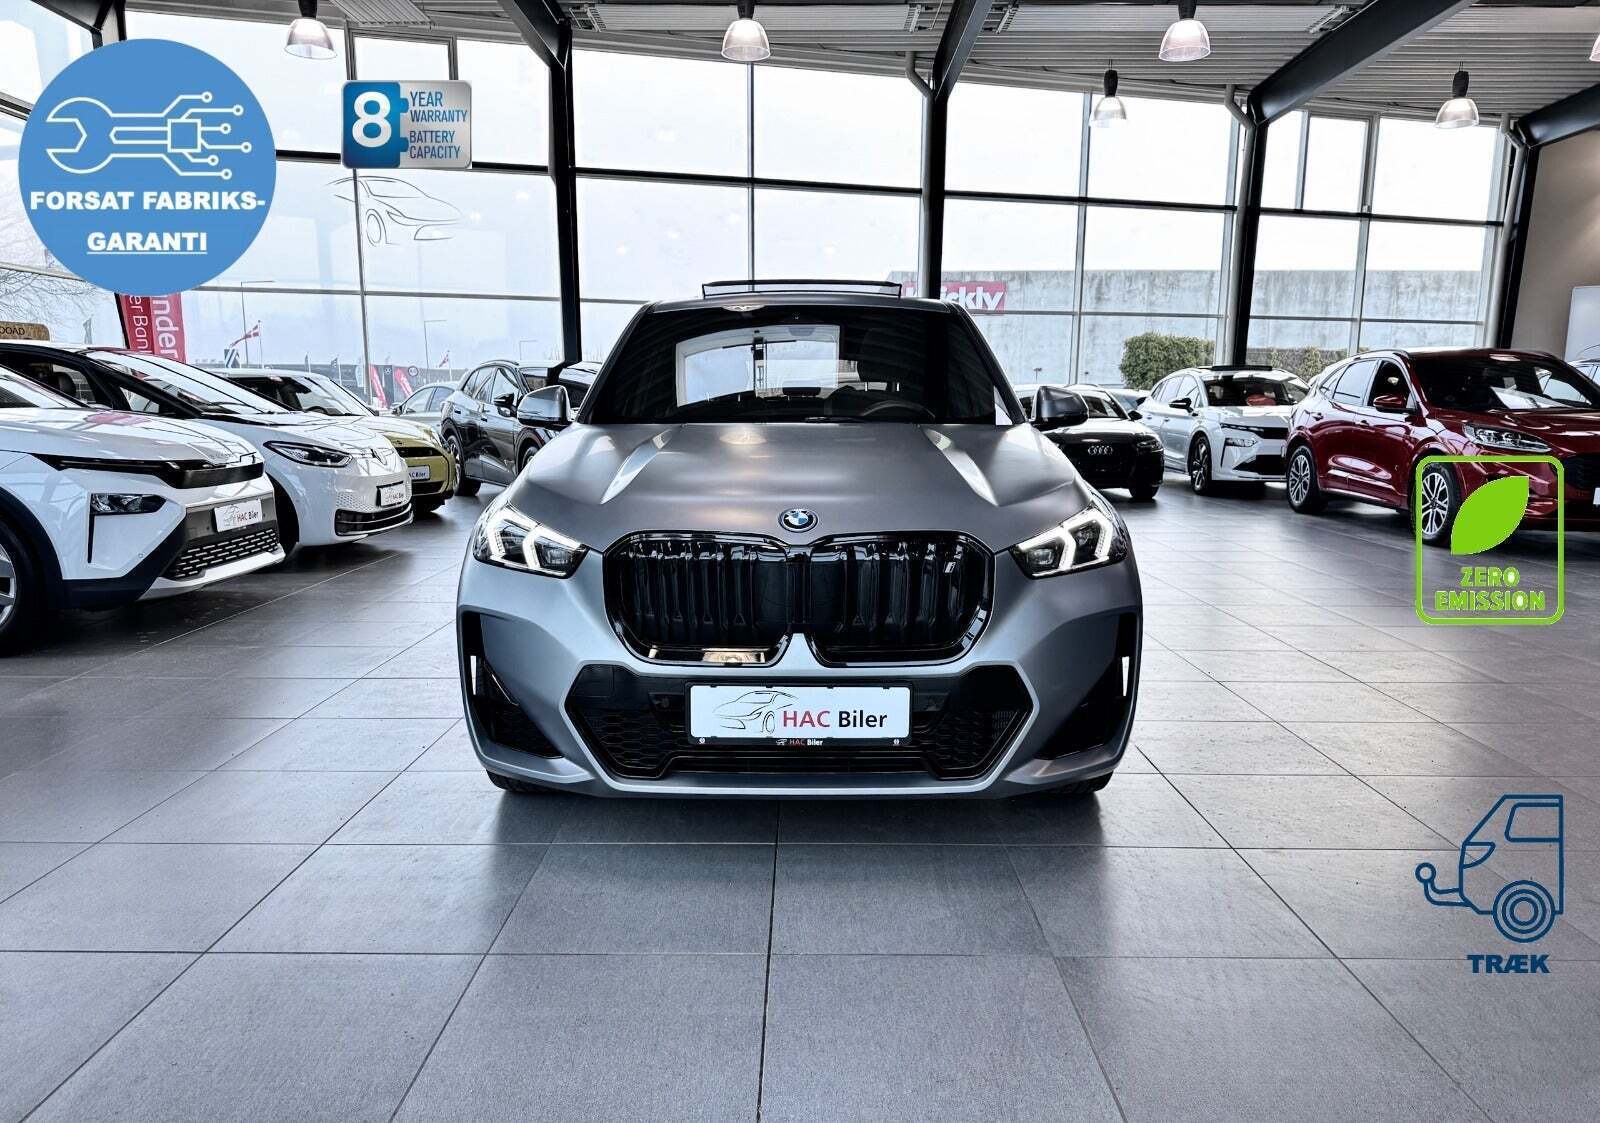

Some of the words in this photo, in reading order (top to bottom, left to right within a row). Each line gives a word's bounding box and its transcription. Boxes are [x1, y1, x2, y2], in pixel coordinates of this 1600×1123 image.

[152, 296, 179, 359] nder
[783, 710, 831, 728] HAC
[838, 709, 888, 728] Biler
